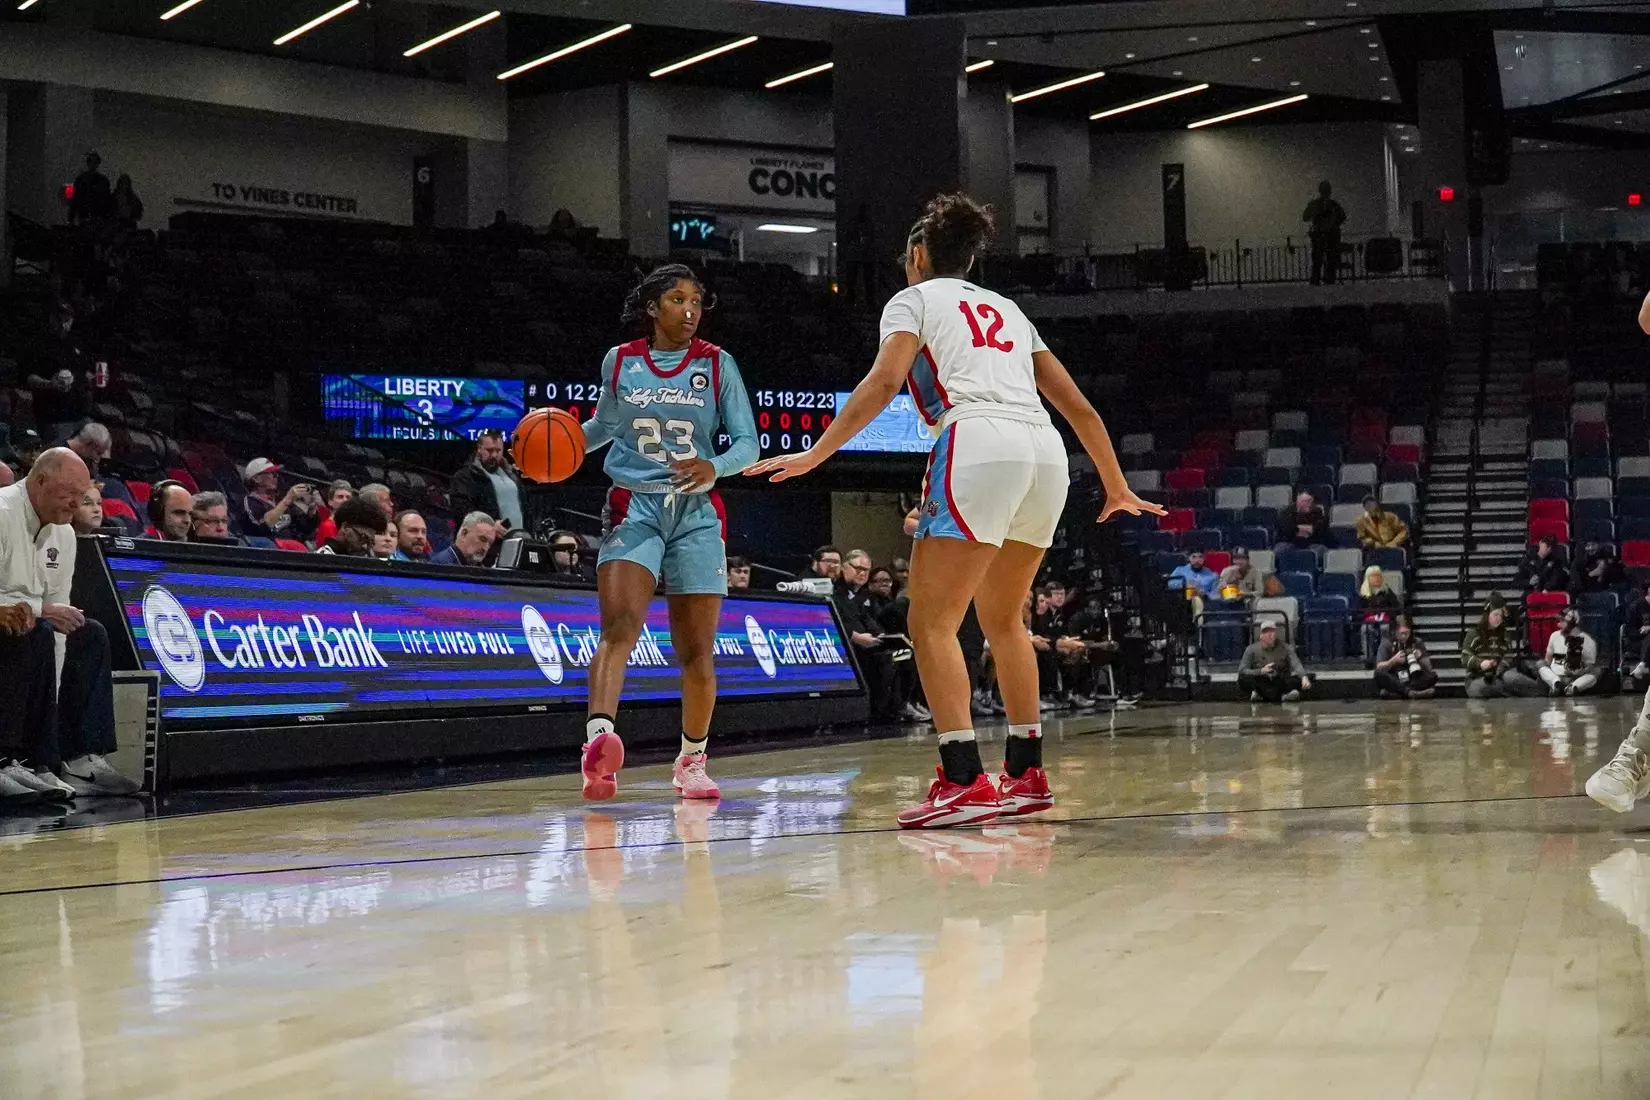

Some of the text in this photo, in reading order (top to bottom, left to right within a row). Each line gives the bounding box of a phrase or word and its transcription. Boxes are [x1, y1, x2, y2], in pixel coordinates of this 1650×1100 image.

[417, 166, 431, 184] 6
[1167, 174, 1181, 190] 7
[213, 183, 357, 213] TO VINES CENTER
[958, 300, 1014, 353] 12
[384, 378, 465, 397] LIBERTY
[528, 383, 604, 401] # 0 12 2
[624, 387, 652, 409] Lady
[756, 390, 836, 409] 15 18 22 23
[759, 411, 770, 430] 0
[780, 411, 791, 430] 0
[801, 413, 812, 430] 0
[631, 417, 698, 462] 23
[760, 433, 812, 450] 0 0 0
[204, 609, 388, 668] Carter Bank
[397, 629, 515, 655] LIFE LIVED FULL
[557, 622, 669, 667] Cart ank
[719, 637, 744, 655] FULL
[768, 628, 844, 664] Carter Bank
